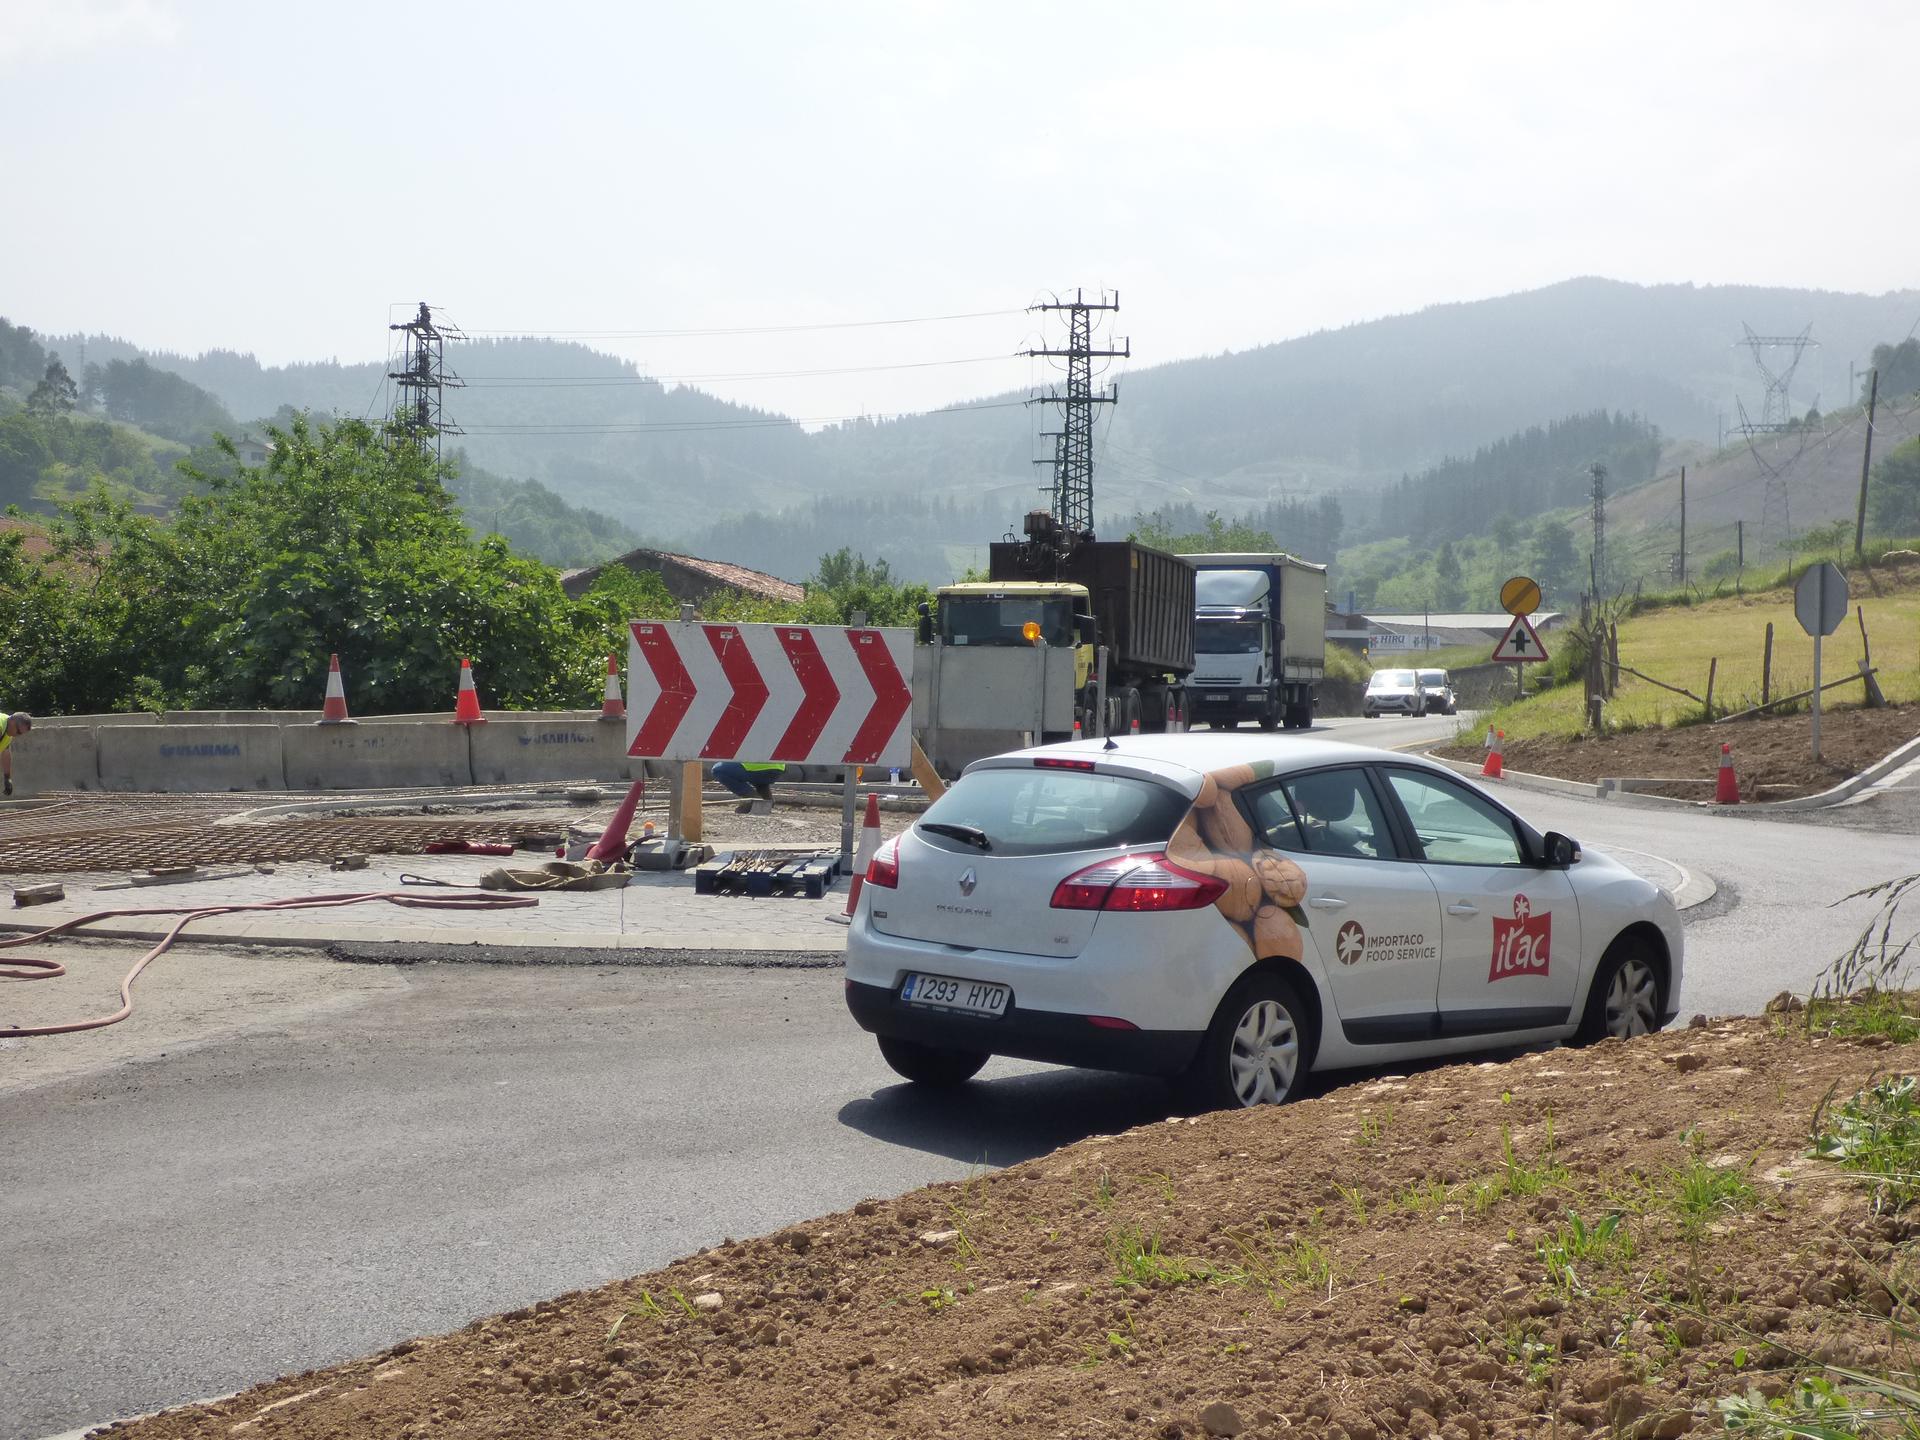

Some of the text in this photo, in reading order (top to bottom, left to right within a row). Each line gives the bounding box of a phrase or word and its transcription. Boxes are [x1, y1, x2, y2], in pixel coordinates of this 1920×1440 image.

[1380, 635, 1405, 644] HIRU
[1367, 934, 1424, 949] IMPORTACO
[1496, 925, 1546, 973] itac
[1366, 947, 1436, 962] FOOD SERVICE
[916, 977, 1004, 1010] 1293 HYD
